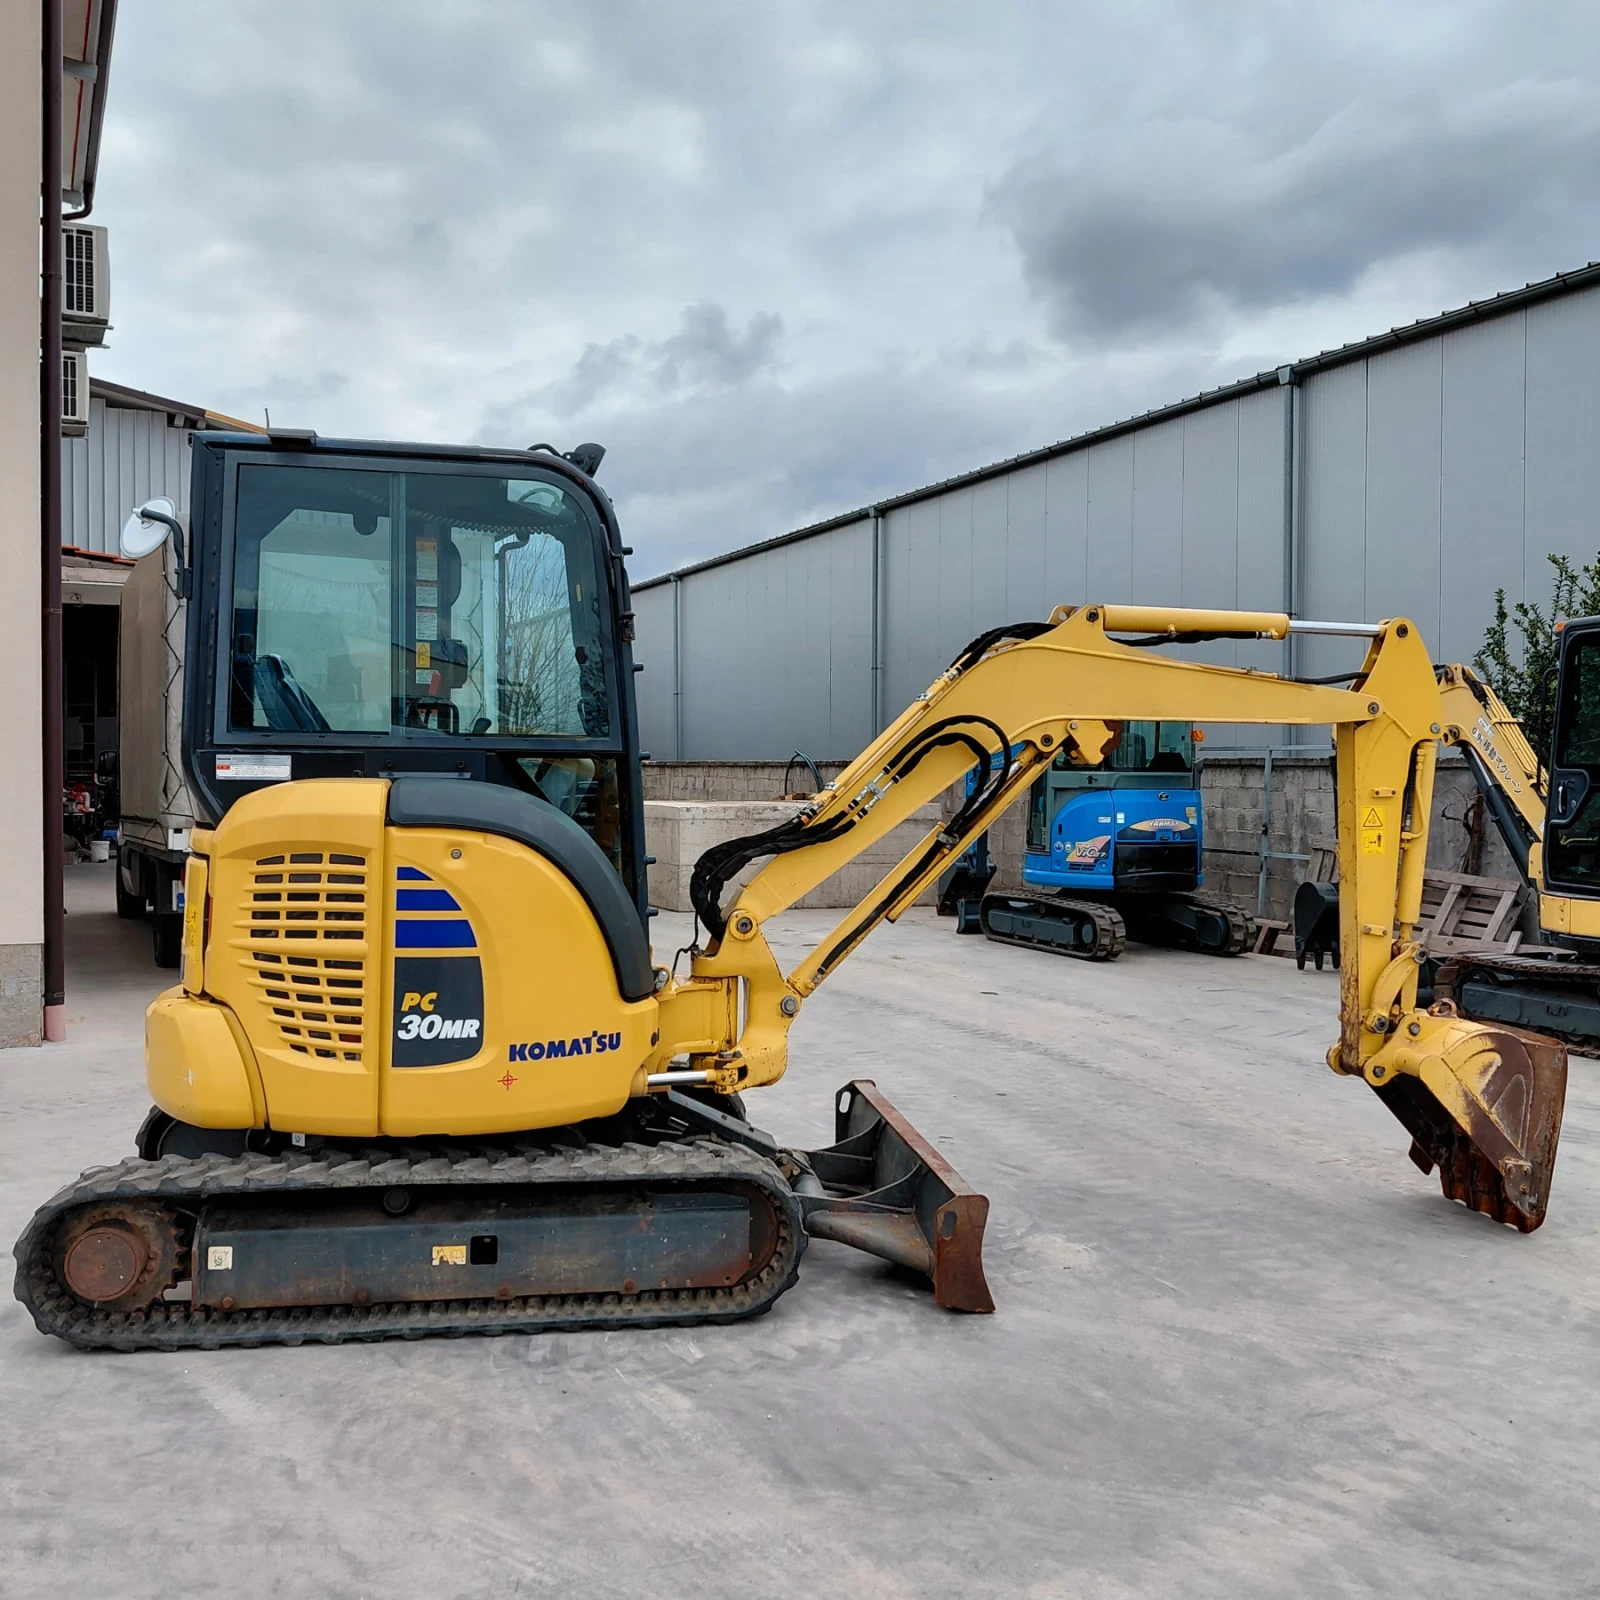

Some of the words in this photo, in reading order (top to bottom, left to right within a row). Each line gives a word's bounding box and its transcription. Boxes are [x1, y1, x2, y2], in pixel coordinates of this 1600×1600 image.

[400, 992, 438, 1012] PC
[397, 1013, 480, 1040] 30MR
[508, 1030, 622, 1062] KOMATSU
